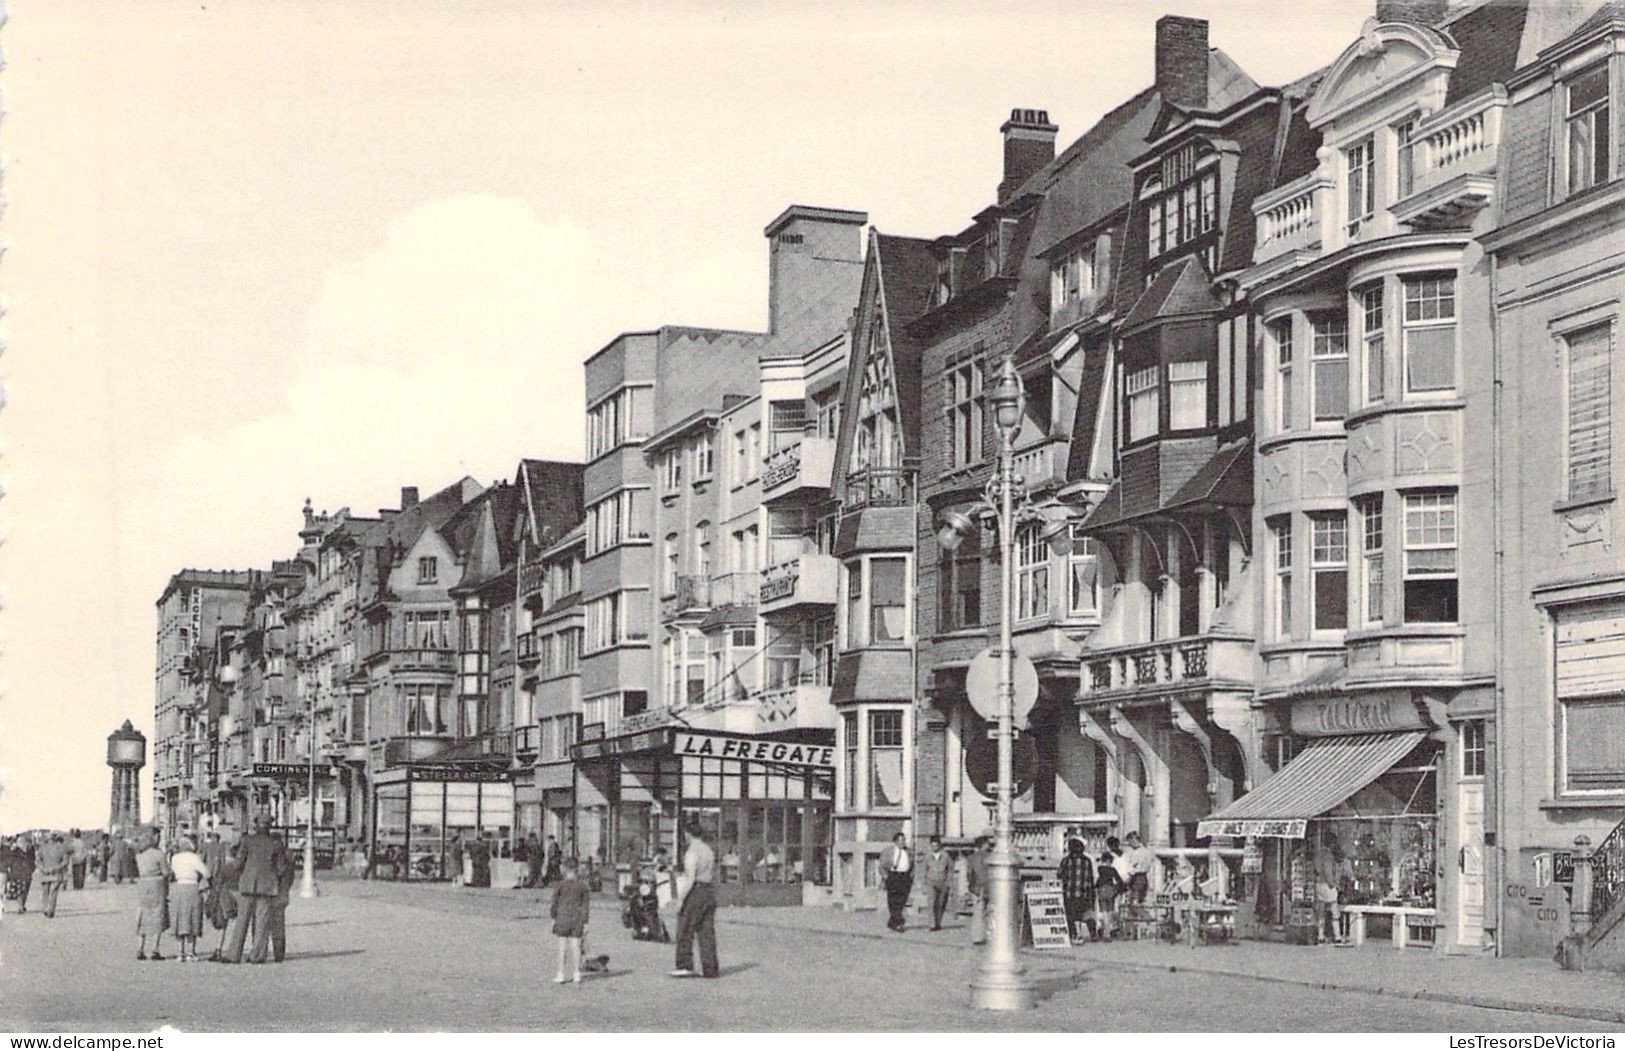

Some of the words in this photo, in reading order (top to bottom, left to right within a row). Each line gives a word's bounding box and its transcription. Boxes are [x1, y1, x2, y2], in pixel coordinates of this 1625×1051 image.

[683, 736, 713, 755] LA
[722, 739, 834, 765] FREGATE
[256, 765, 329, 774] CONTINENAL
